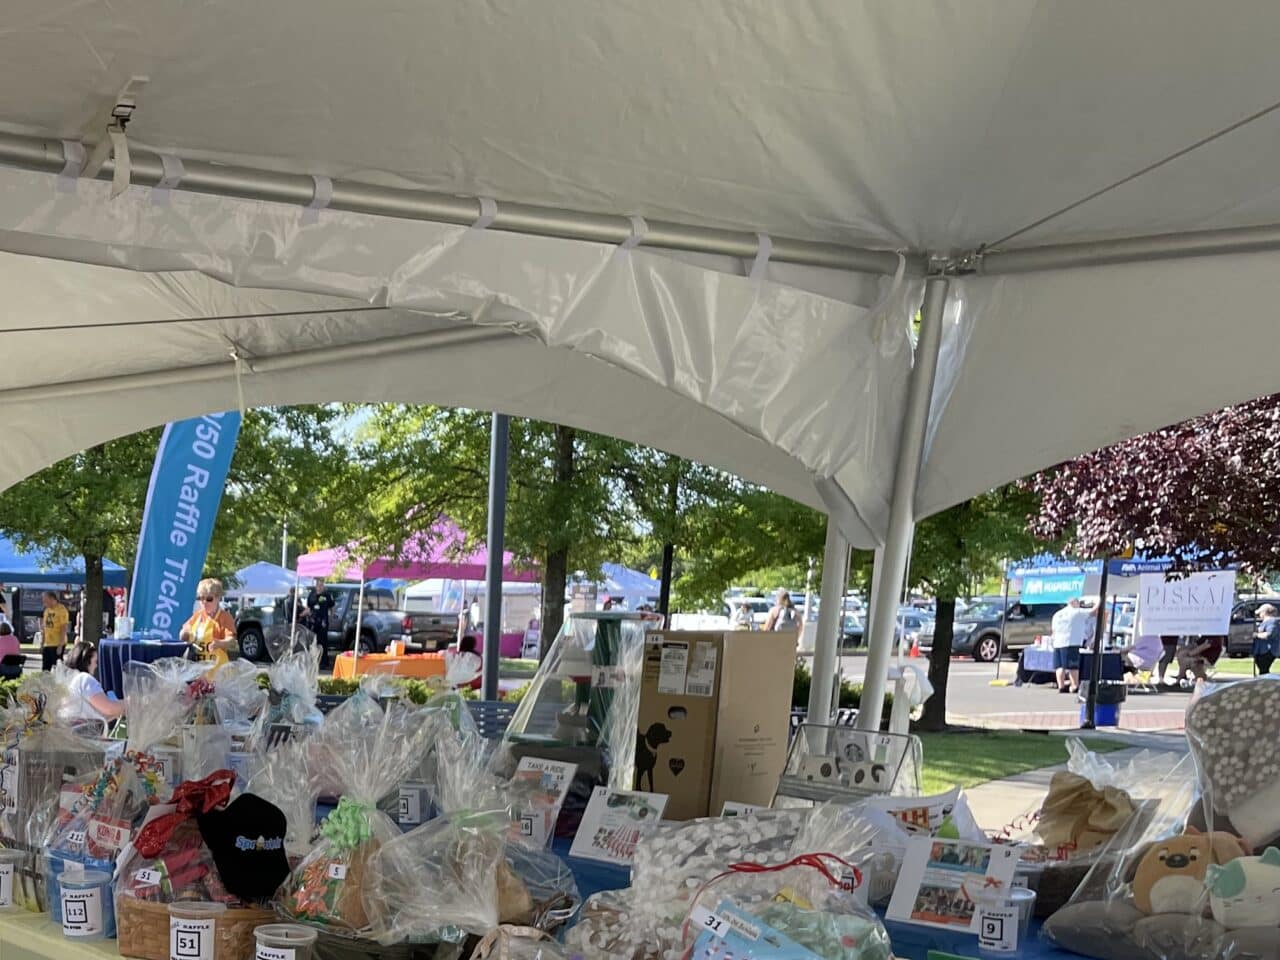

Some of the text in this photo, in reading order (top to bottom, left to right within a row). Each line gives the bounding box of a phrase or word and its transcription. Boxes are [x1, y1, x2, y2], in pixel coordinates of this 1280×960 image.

[170, 463, 210, 547] Raffle
[140, 871, 152, 881] 51
[66, 906, 84, 916] 112
[704, 915, 722, 932] 31
[986, 923, 995, 934] 9
[178, 937, 197, 950] 51
